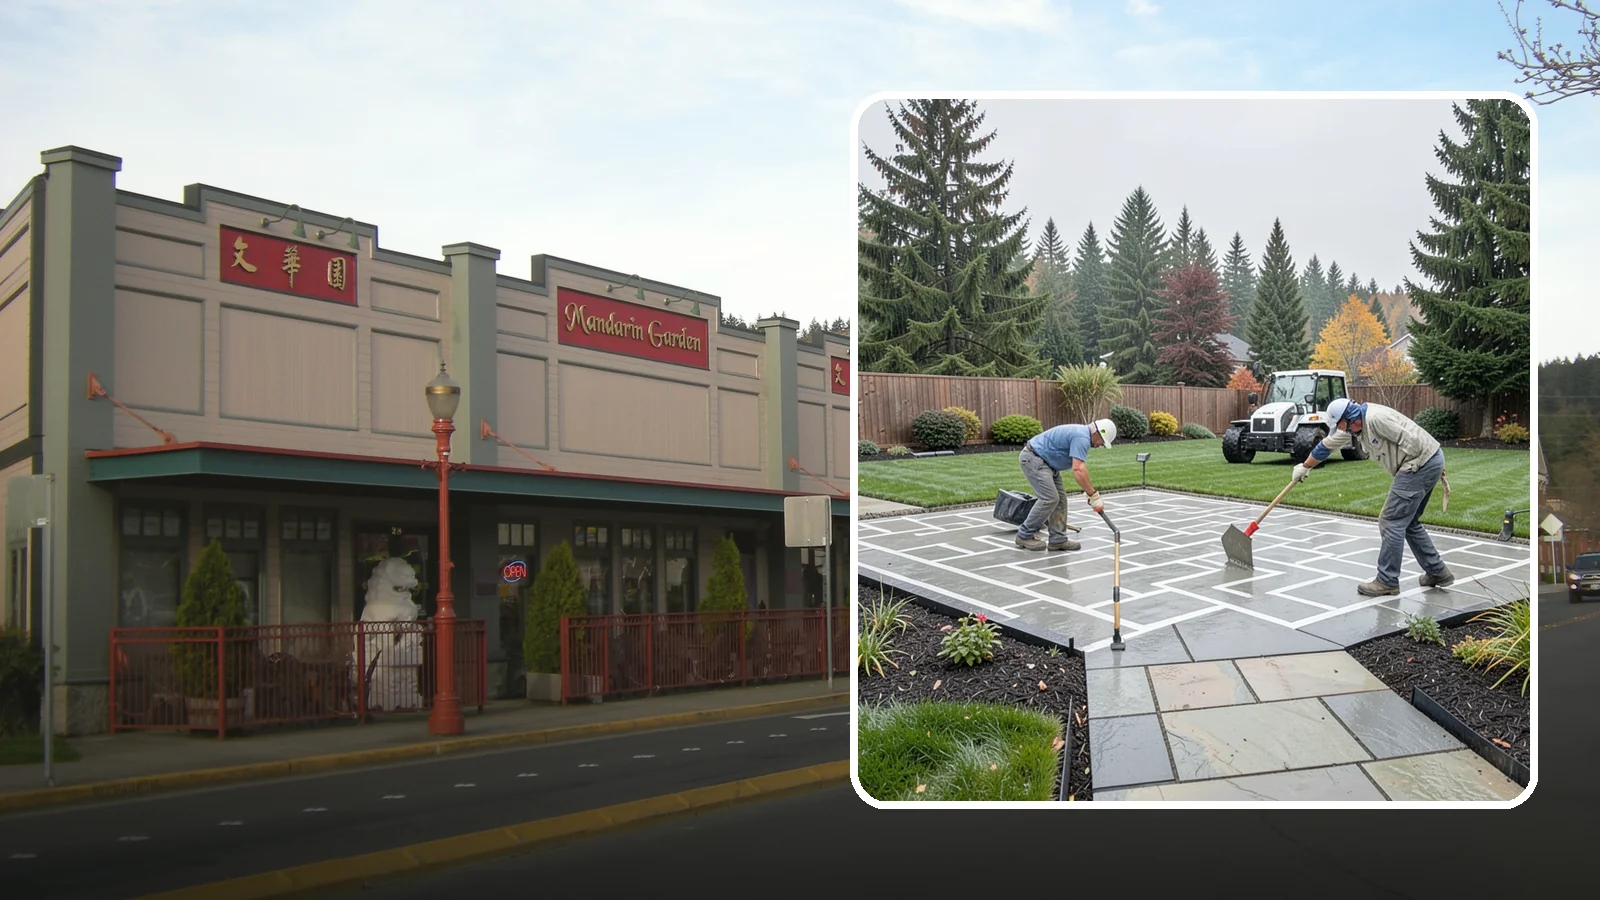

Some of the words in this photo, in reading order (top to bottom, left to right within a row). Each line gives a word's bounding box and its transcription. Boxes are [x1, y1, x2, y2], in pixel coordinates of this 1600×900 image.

[231, 235, 346, 290] 文華園
[564, 302, 644, 341] Mandarin
[648, 320, 701, 352] Garden
[503, 565, 527, 578] OPEN
